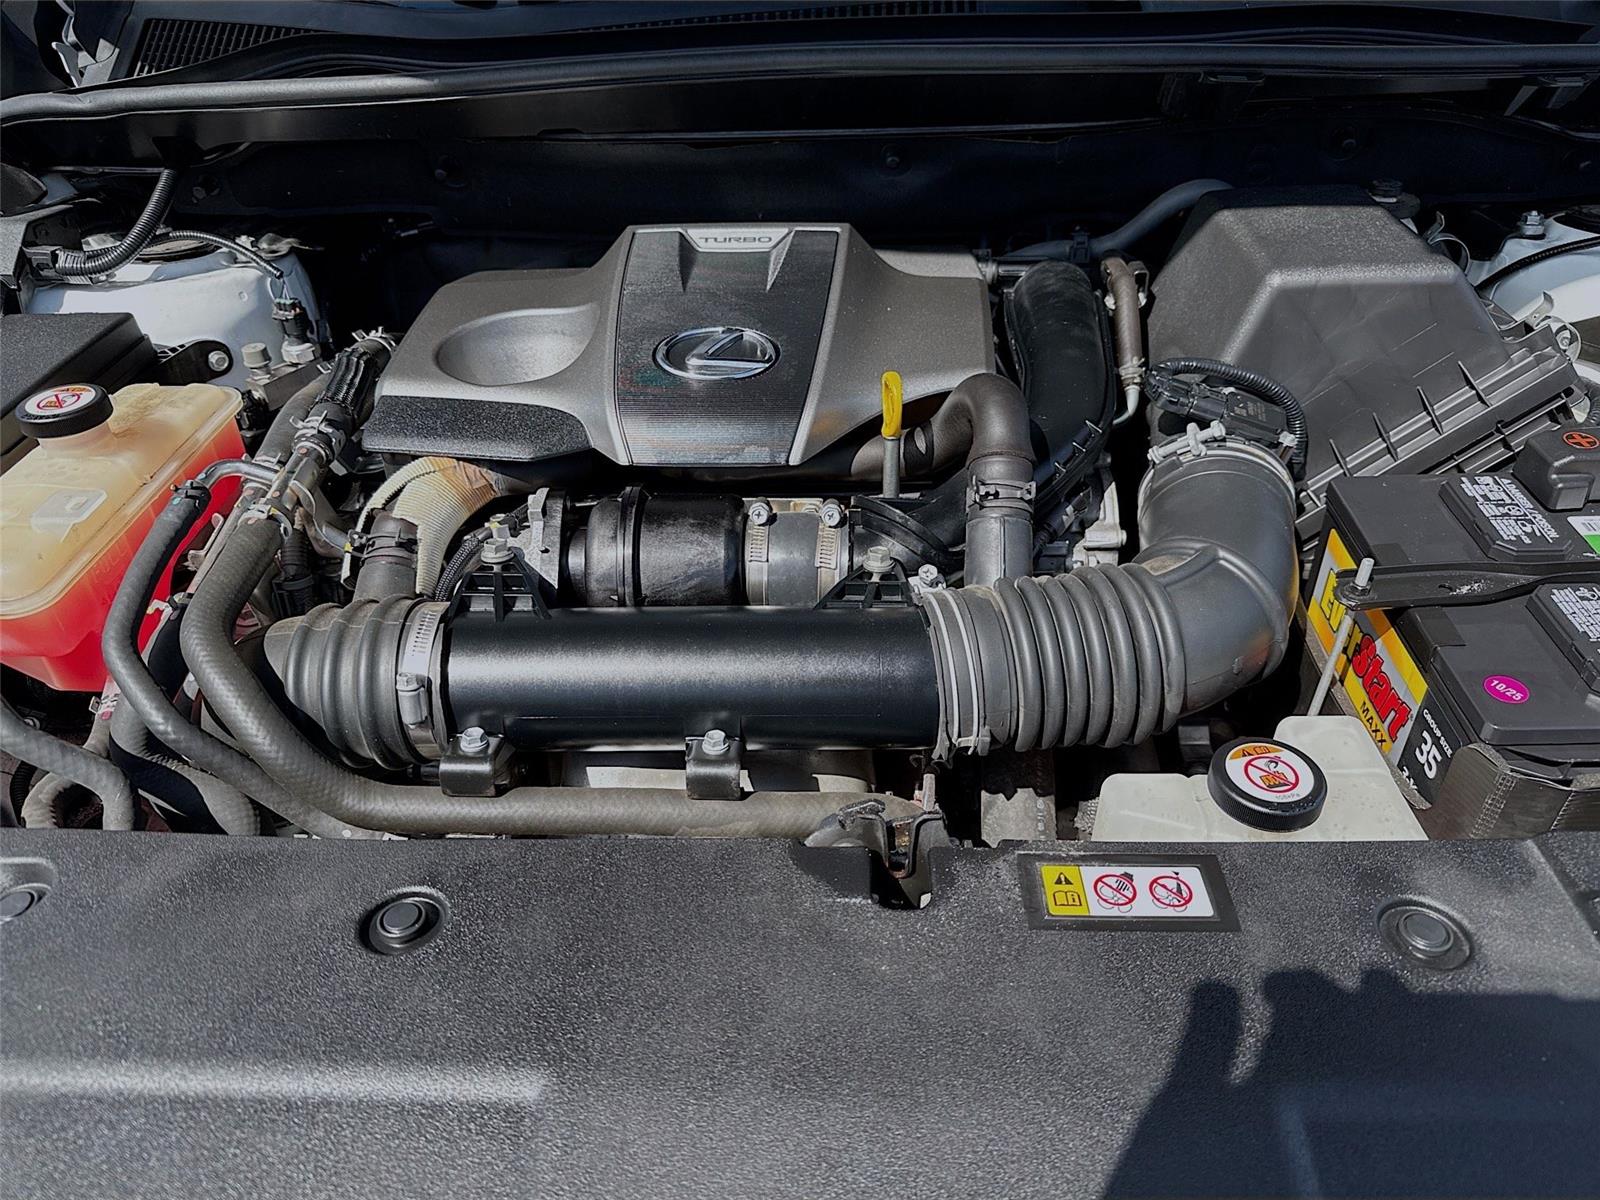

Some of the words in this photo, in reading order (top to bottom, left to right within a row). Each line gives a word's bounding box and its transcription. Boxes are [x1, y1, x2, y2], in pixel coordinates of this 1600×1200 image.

[699, 236, 773, 244] TURBO
[1505, 483, 1535, 509] DANGER
[1531, 513, 1560, 538] POISON
[1490, 679, 1524, 700] 10/25
[1359, 701, 1387, 747] MAXX
[1423, 708, 1441, 737] GROUP
[1440, 736, 1453, 758] SIZE
[1415, 730, 1442, 779] 35
